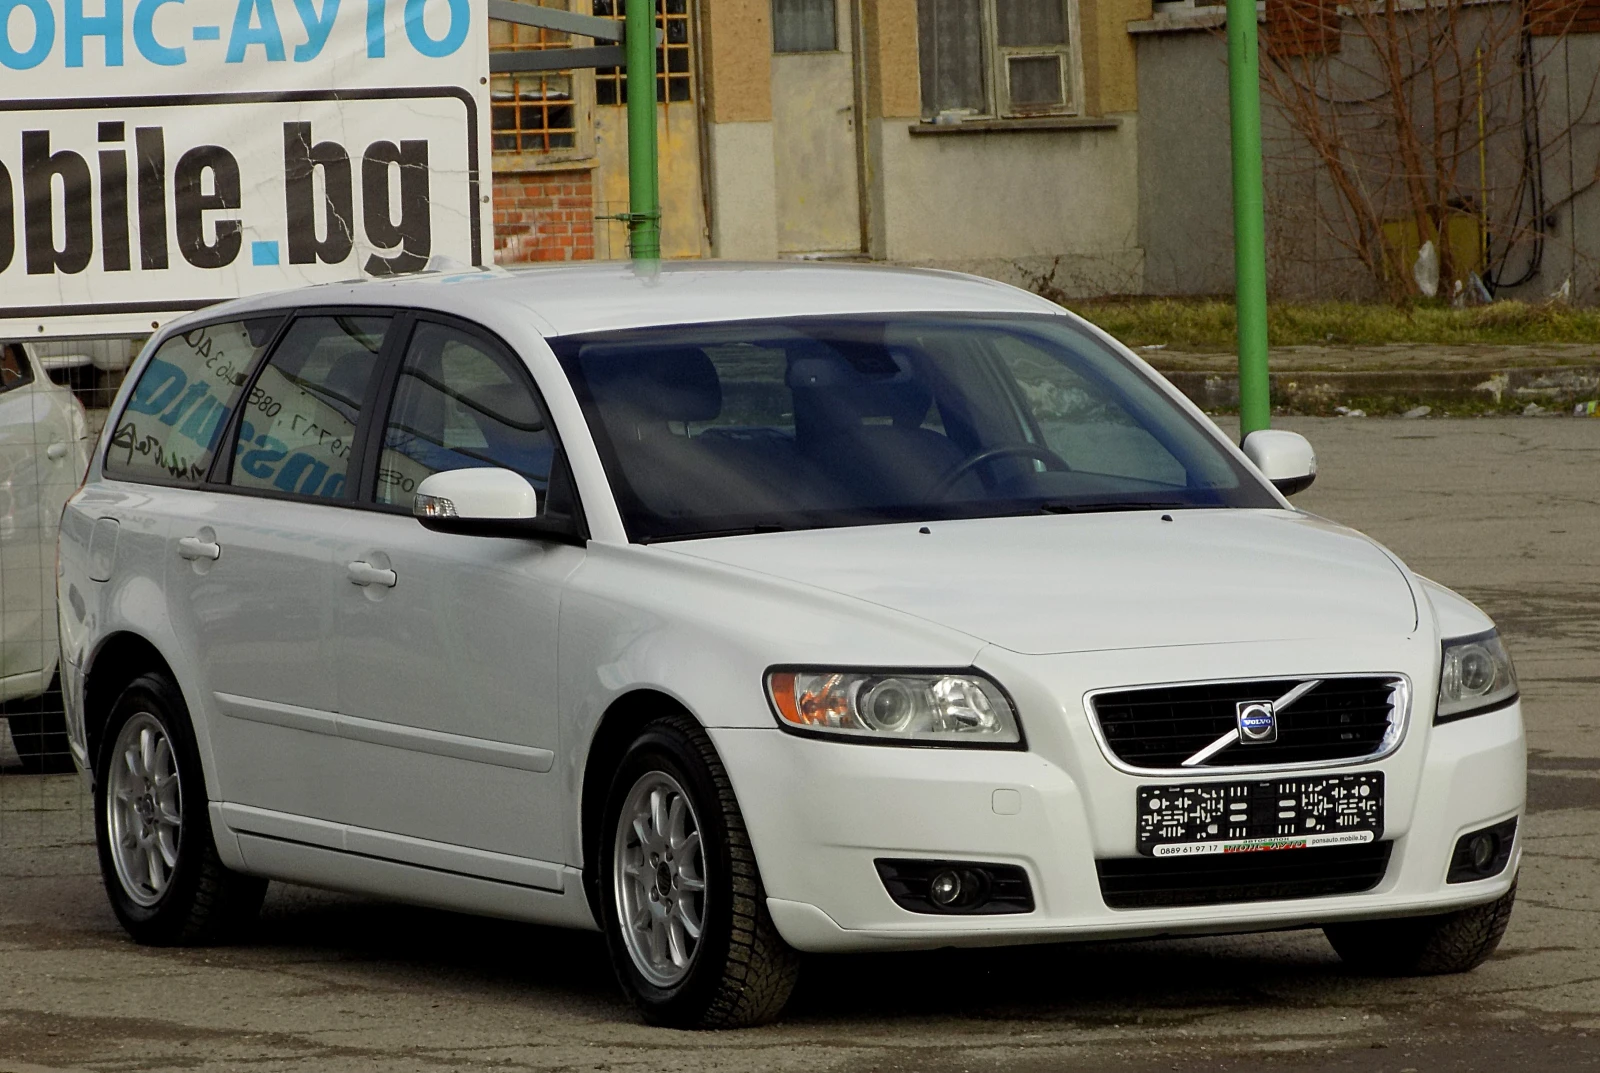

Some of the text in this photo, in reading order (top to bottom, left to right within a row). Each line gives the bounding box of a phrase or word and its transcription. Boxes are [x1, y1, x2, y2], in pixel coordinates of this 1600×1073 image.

[0, 121, 431, 278] bile.bg
[1243, 718, 1271, 726] VOLVO
[1311, 834, 1368, 846] ponsauto.mobile.bg
[1160, 847, 1181, 855] 0889
[1195, 845, 1206, 853] 97
[1209, 844, 1218, 852] 17
